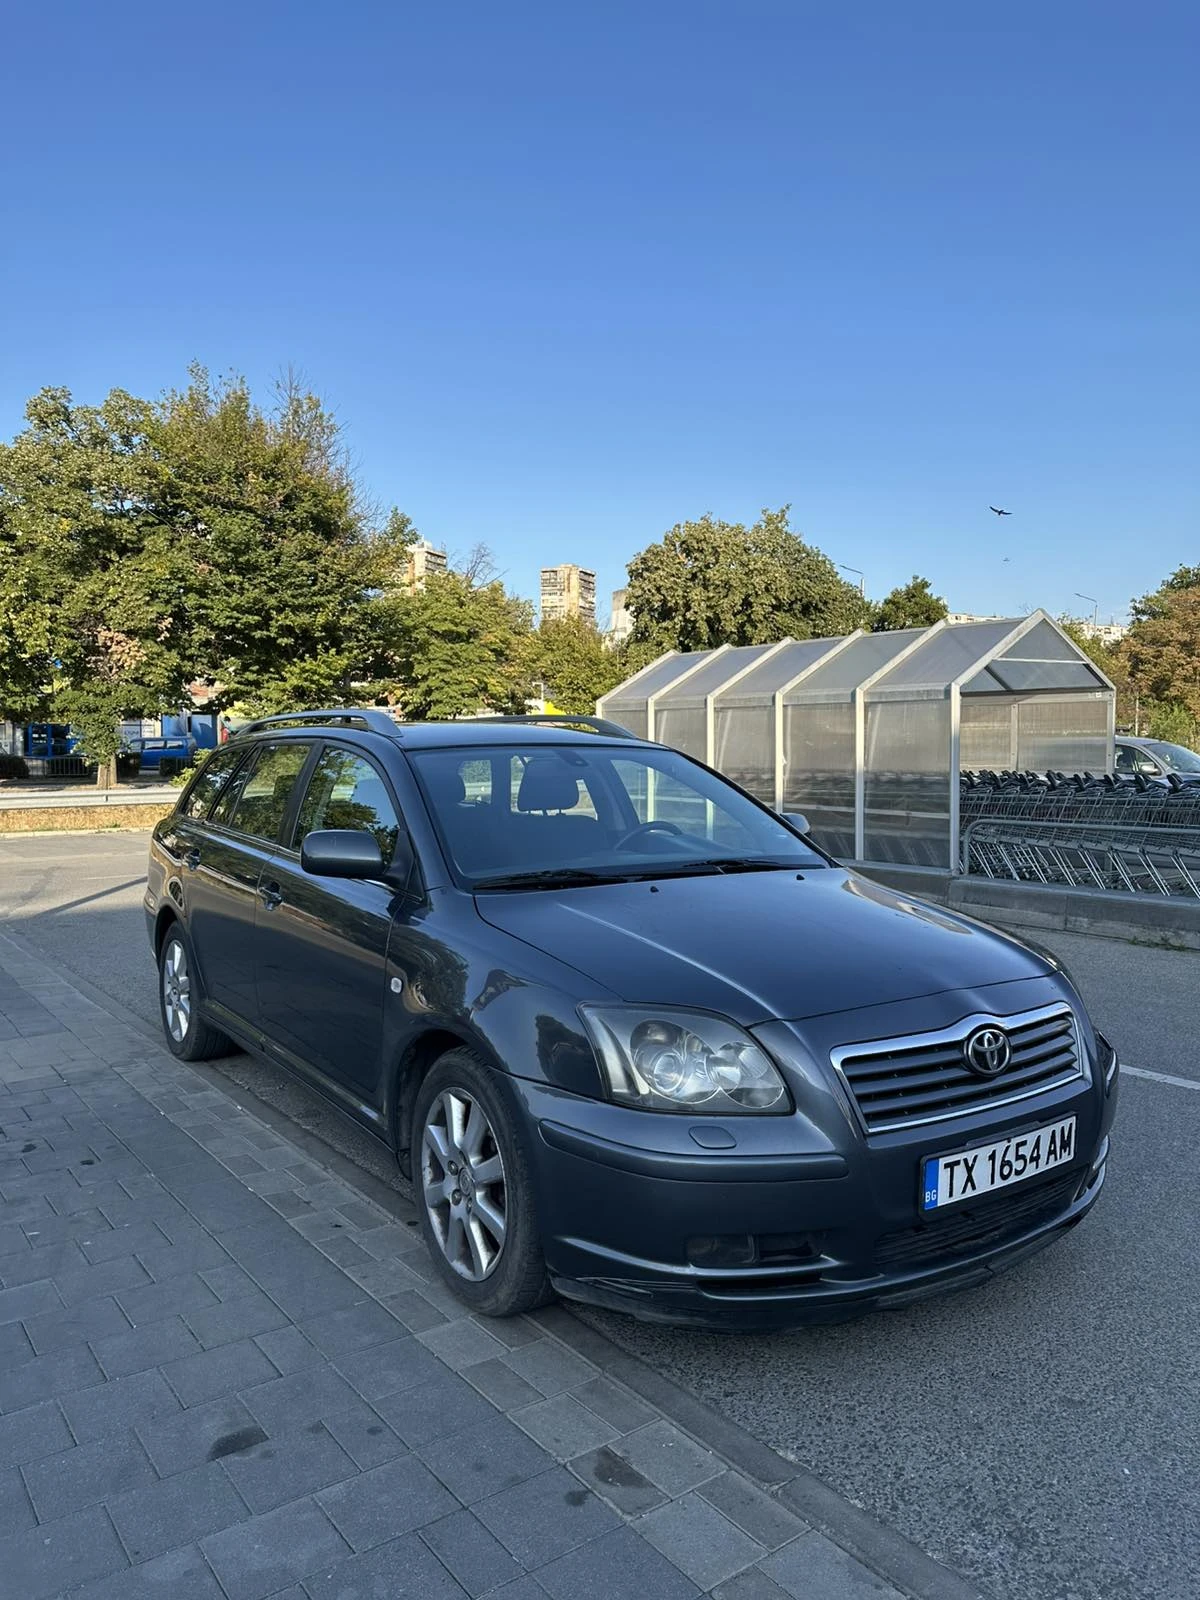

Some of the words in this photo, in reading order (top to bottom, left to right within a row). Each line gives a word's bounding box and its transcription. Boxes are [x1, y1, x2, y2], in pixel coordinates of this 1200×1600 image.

[943, 1154, 978, 1198] TX
[988, 1135, 1041, 1185] 1654
[1045, 1121, 1073, 1165] AM
[925, 1189, 937, 1203] BG
